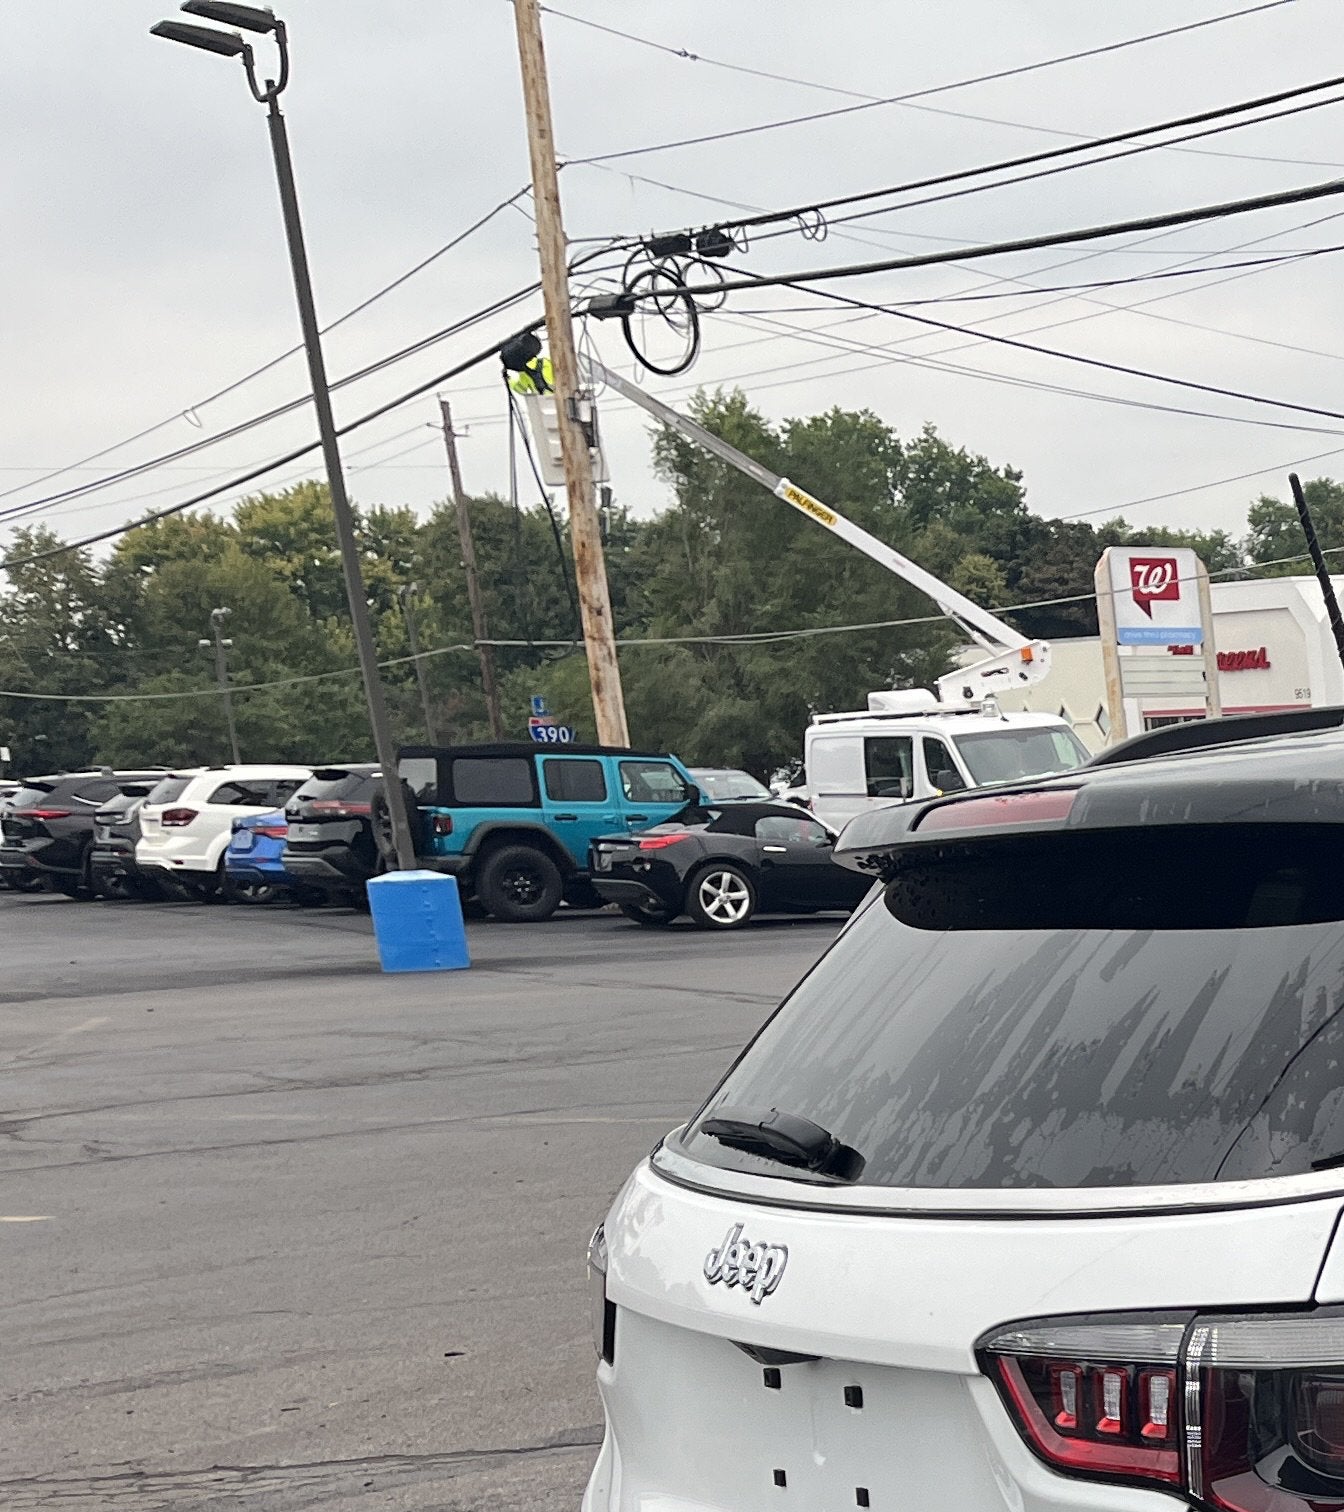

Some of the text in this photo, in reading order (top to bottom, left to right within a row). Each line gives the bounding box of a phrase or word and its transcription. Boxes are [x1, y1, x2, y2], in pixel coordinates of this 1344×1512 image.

[1133, 562, 1172, 595] W
[536, 726, 570, 743] 390
[703, 1222, 789, 1306] Jeep
